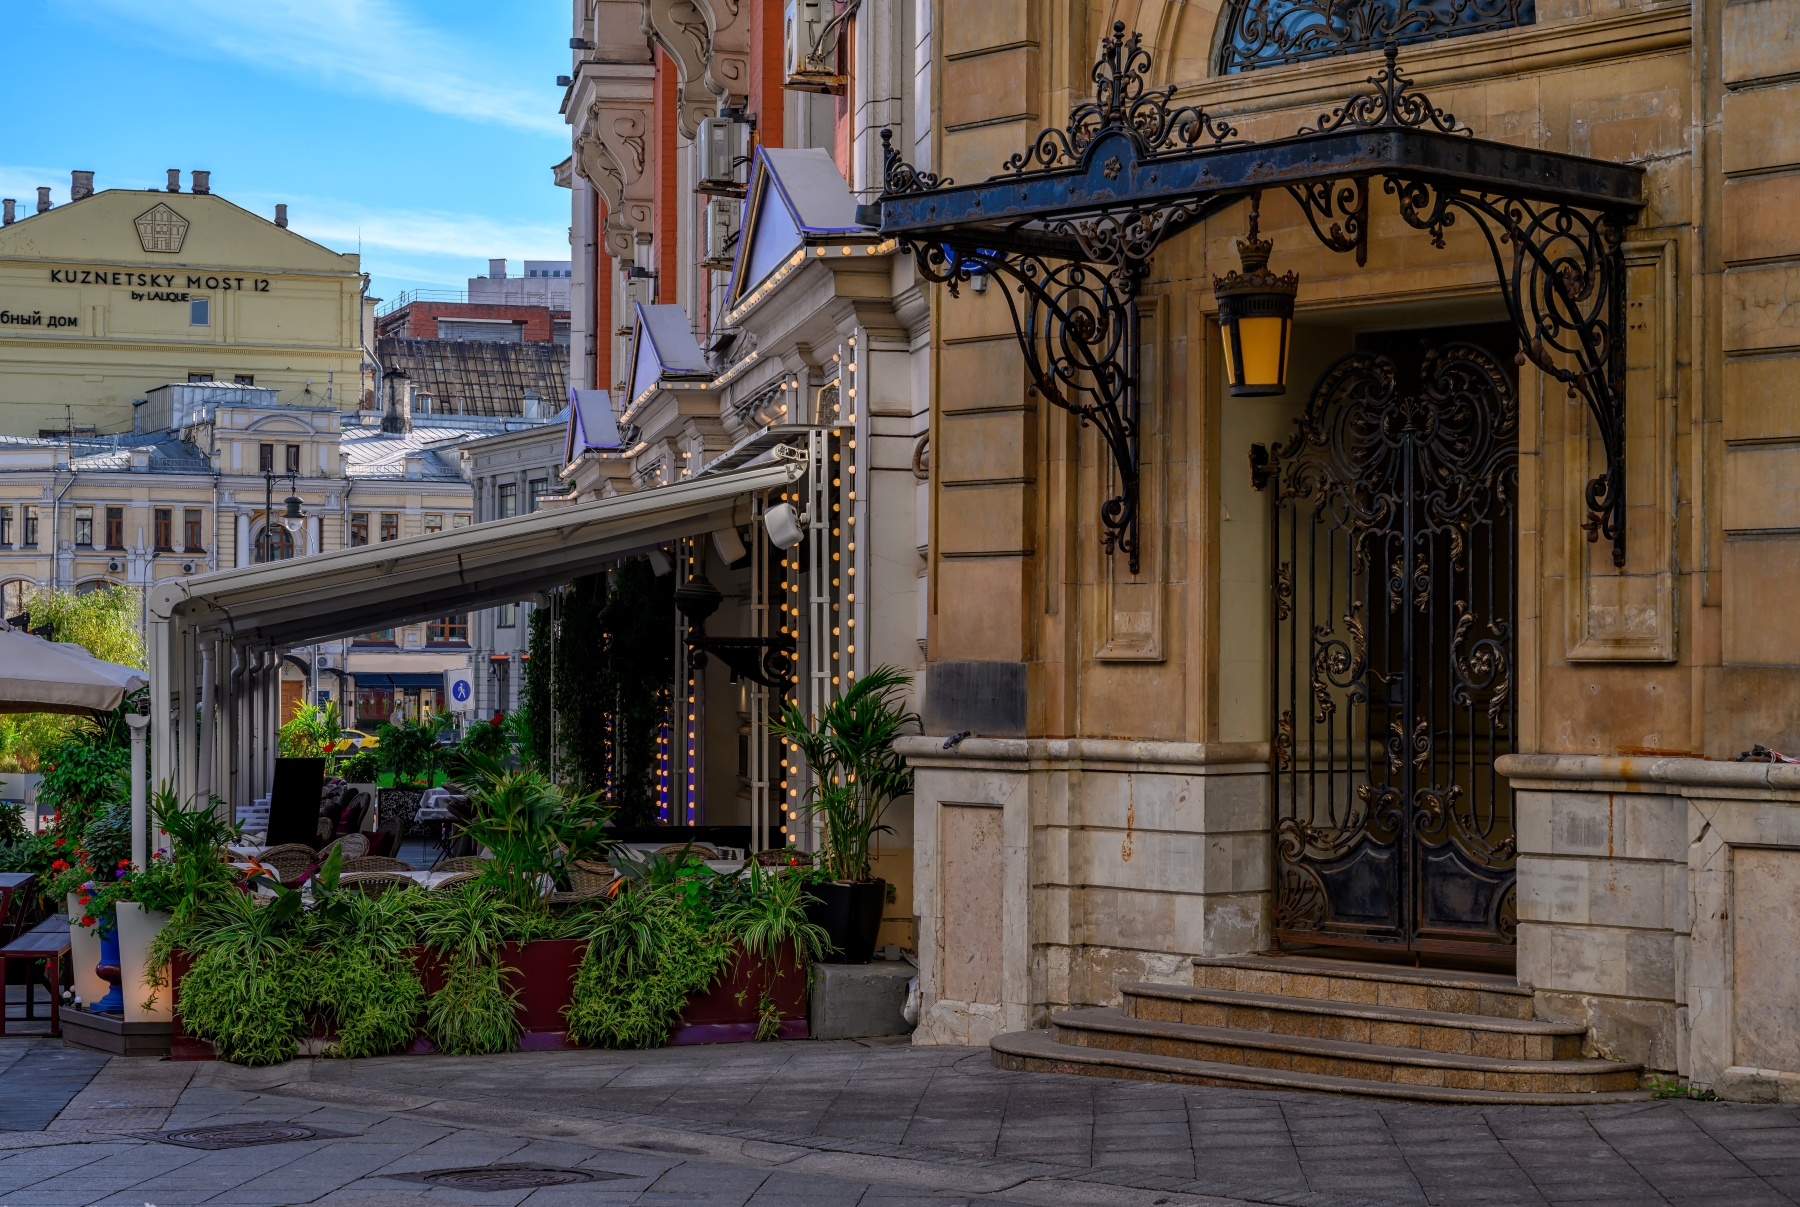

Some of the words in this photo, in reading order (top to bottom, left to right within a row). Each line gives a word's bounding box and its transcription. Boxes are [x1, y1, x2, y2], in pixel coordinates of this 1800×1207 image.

[51, 269, 174, 287] KUZNETSKY
[187, 275, 244, 291] MOST
[254, 278, 270, 292] 12
[131, 290, 144, 302] by
[147, 291, 190, 302] LALIQUE
[47, 315, 78, 328] дом
